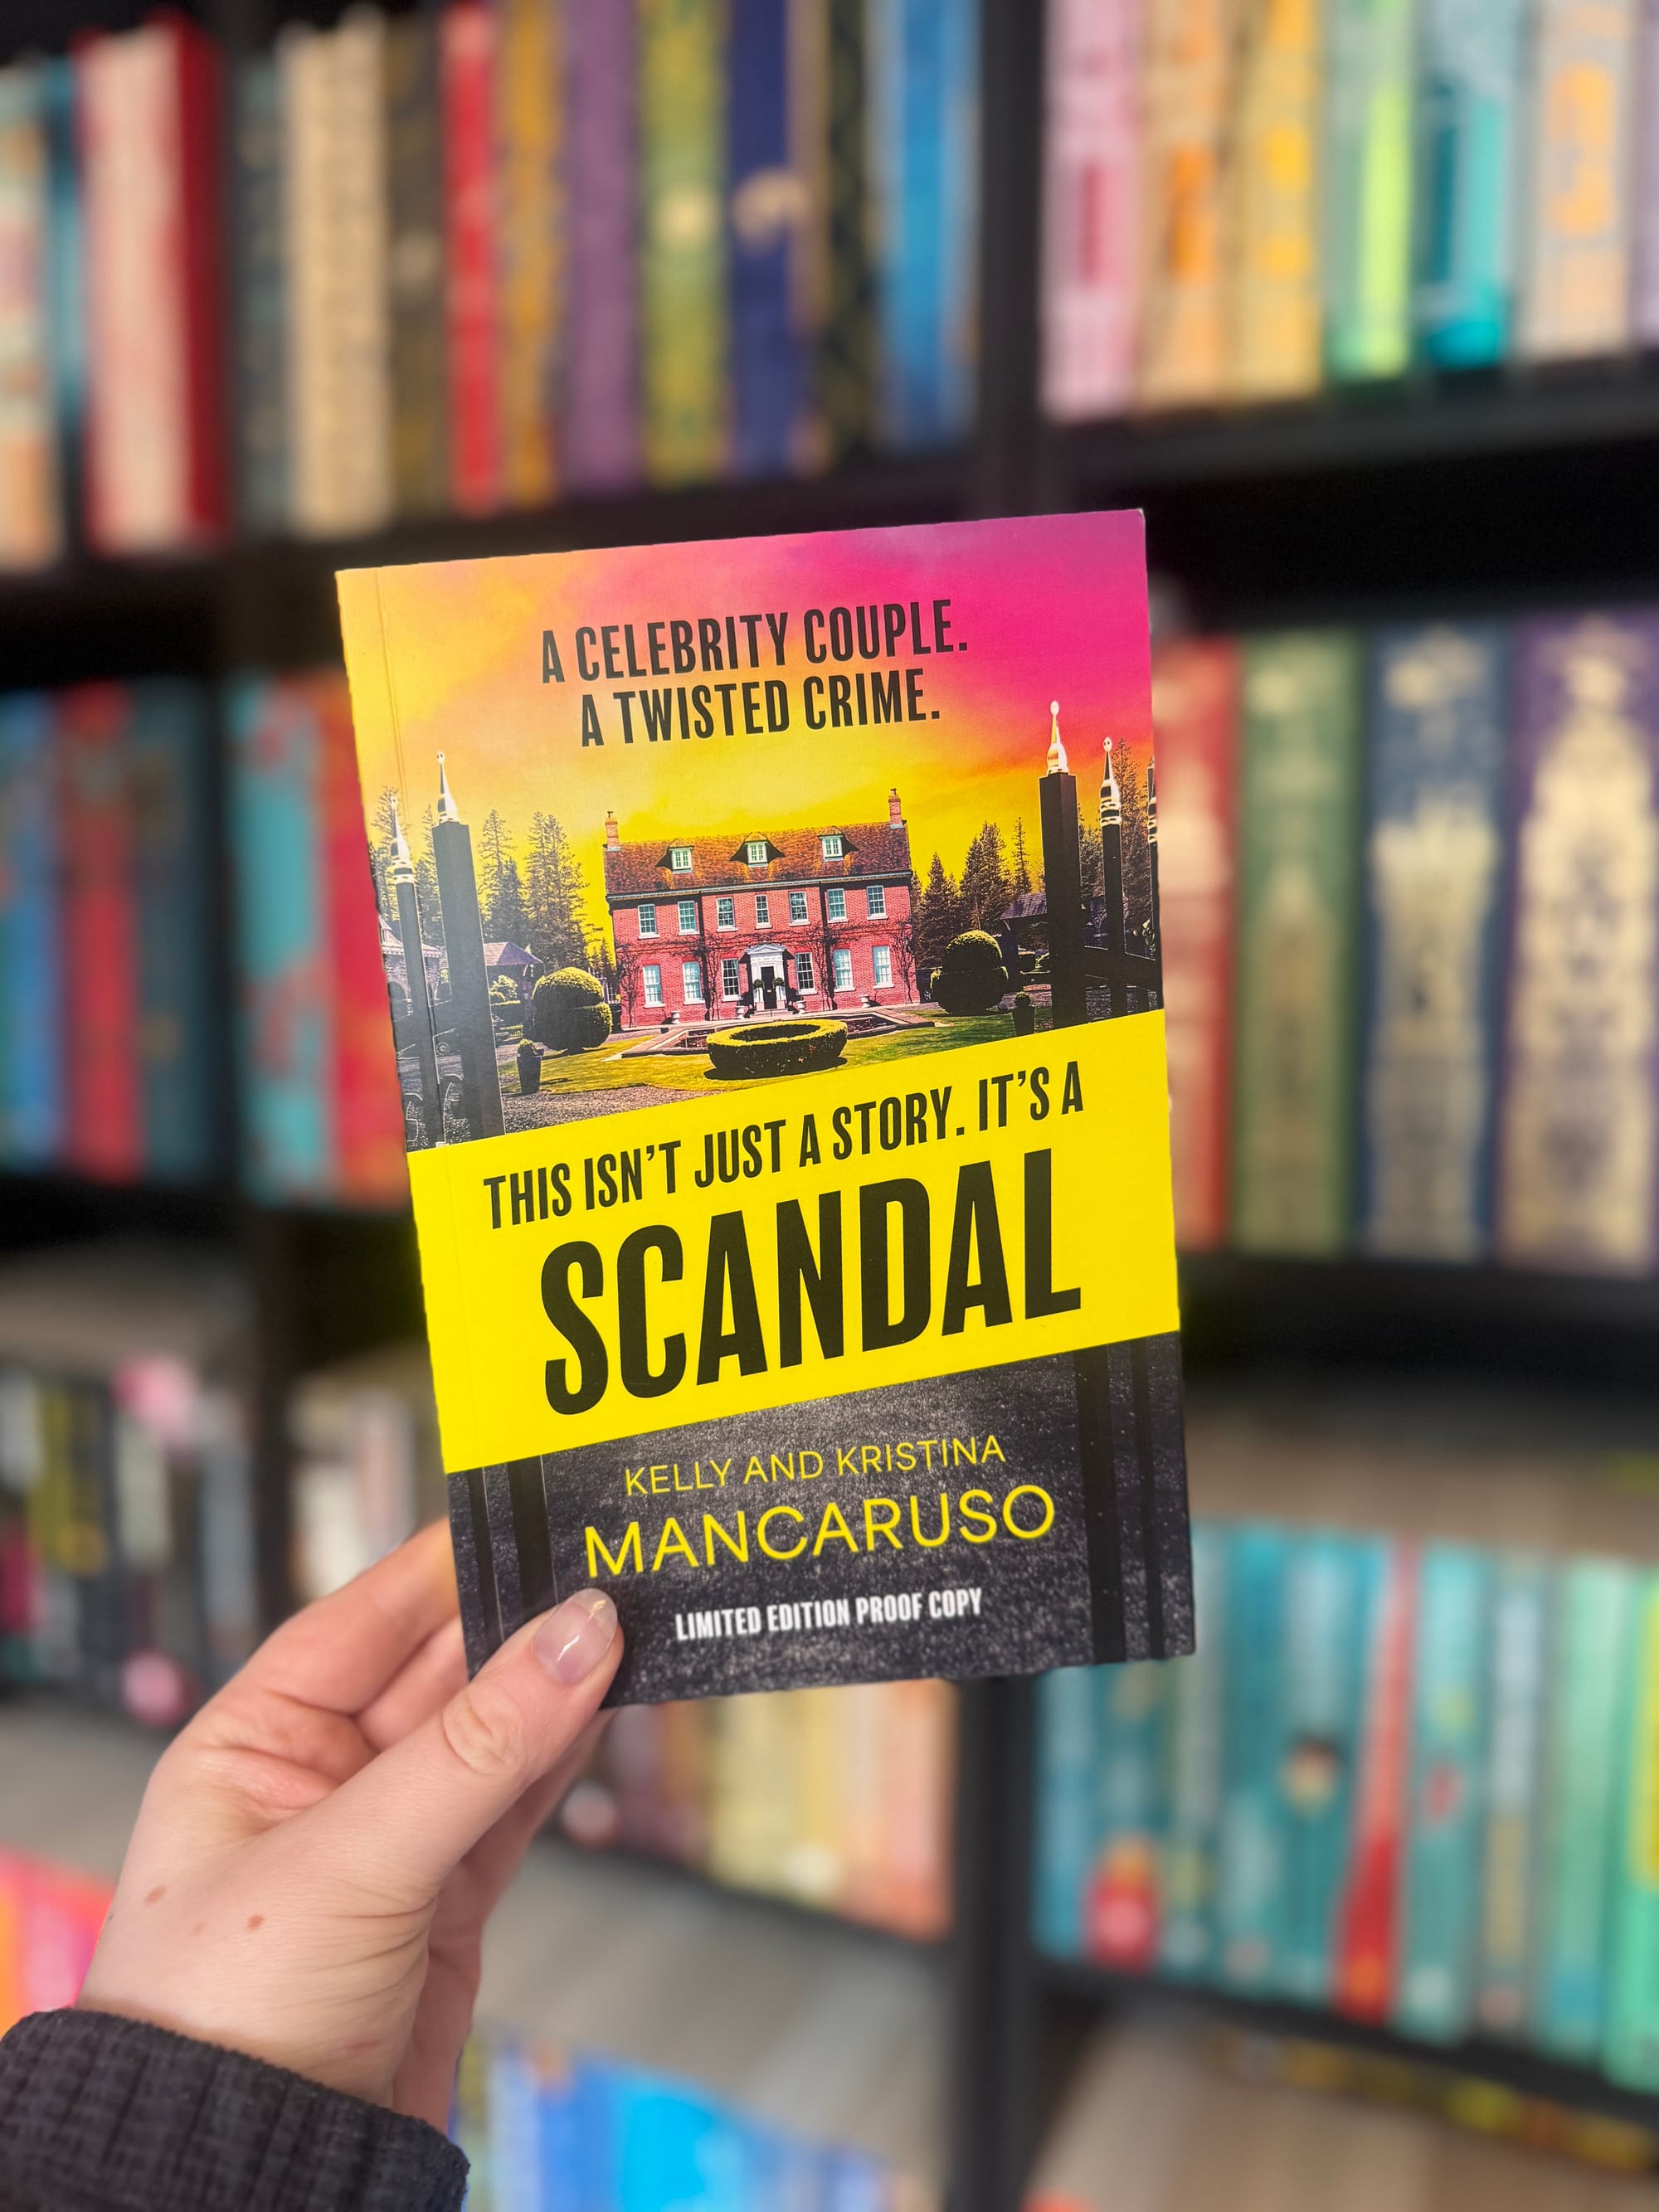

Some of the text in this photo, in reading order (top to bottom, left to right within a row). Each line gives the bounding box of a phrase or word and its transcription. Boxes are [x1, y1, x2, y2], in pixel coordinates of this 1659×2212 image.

[542, 599, 968, 683] A CELEBRITY COUPLE.
[581, 668, 940, 746] A TWISTED CRIME.
[484, 1060, 1083, 1229] THIS ISN'T JUST A STORY. IT'S A
[541, 1148, 1082, 1415] SCANDAL
[625, 1435, 1006, 1496] KELLY AND KRISTINA
[584, 1485, 1054, 1578] MANCARUSO
[675, 1587, 982, 1641] LIMITED EDITION PROOF COPY
